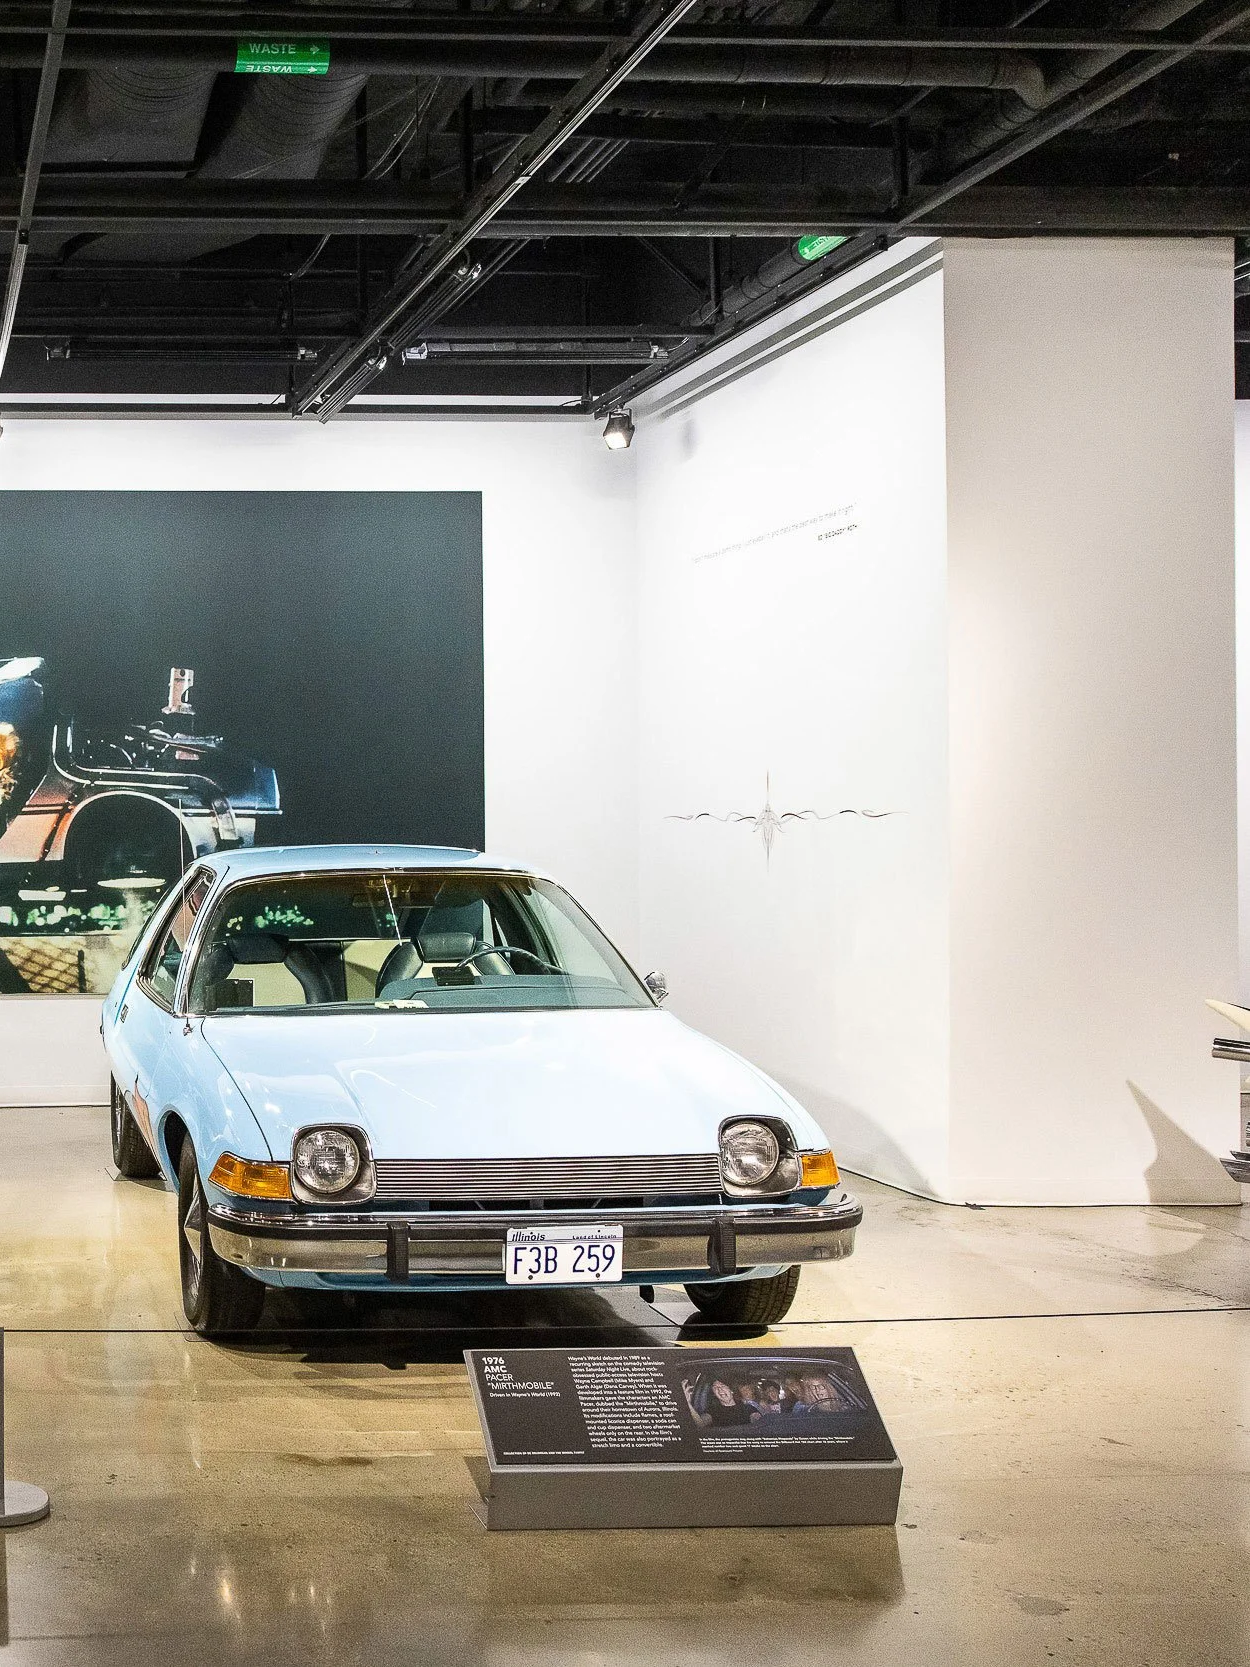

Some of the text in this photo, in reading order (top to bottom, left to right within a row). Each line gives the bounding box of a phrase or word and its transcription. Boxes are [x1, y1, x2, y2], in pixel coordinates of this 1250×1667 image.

[250, 44, 296, 54] WASTE
[246, 65, 292, 73] WASTE
[512, 1232, 545, 1241] Illinois
[514, 1245, 615, 1274] F3B 259
